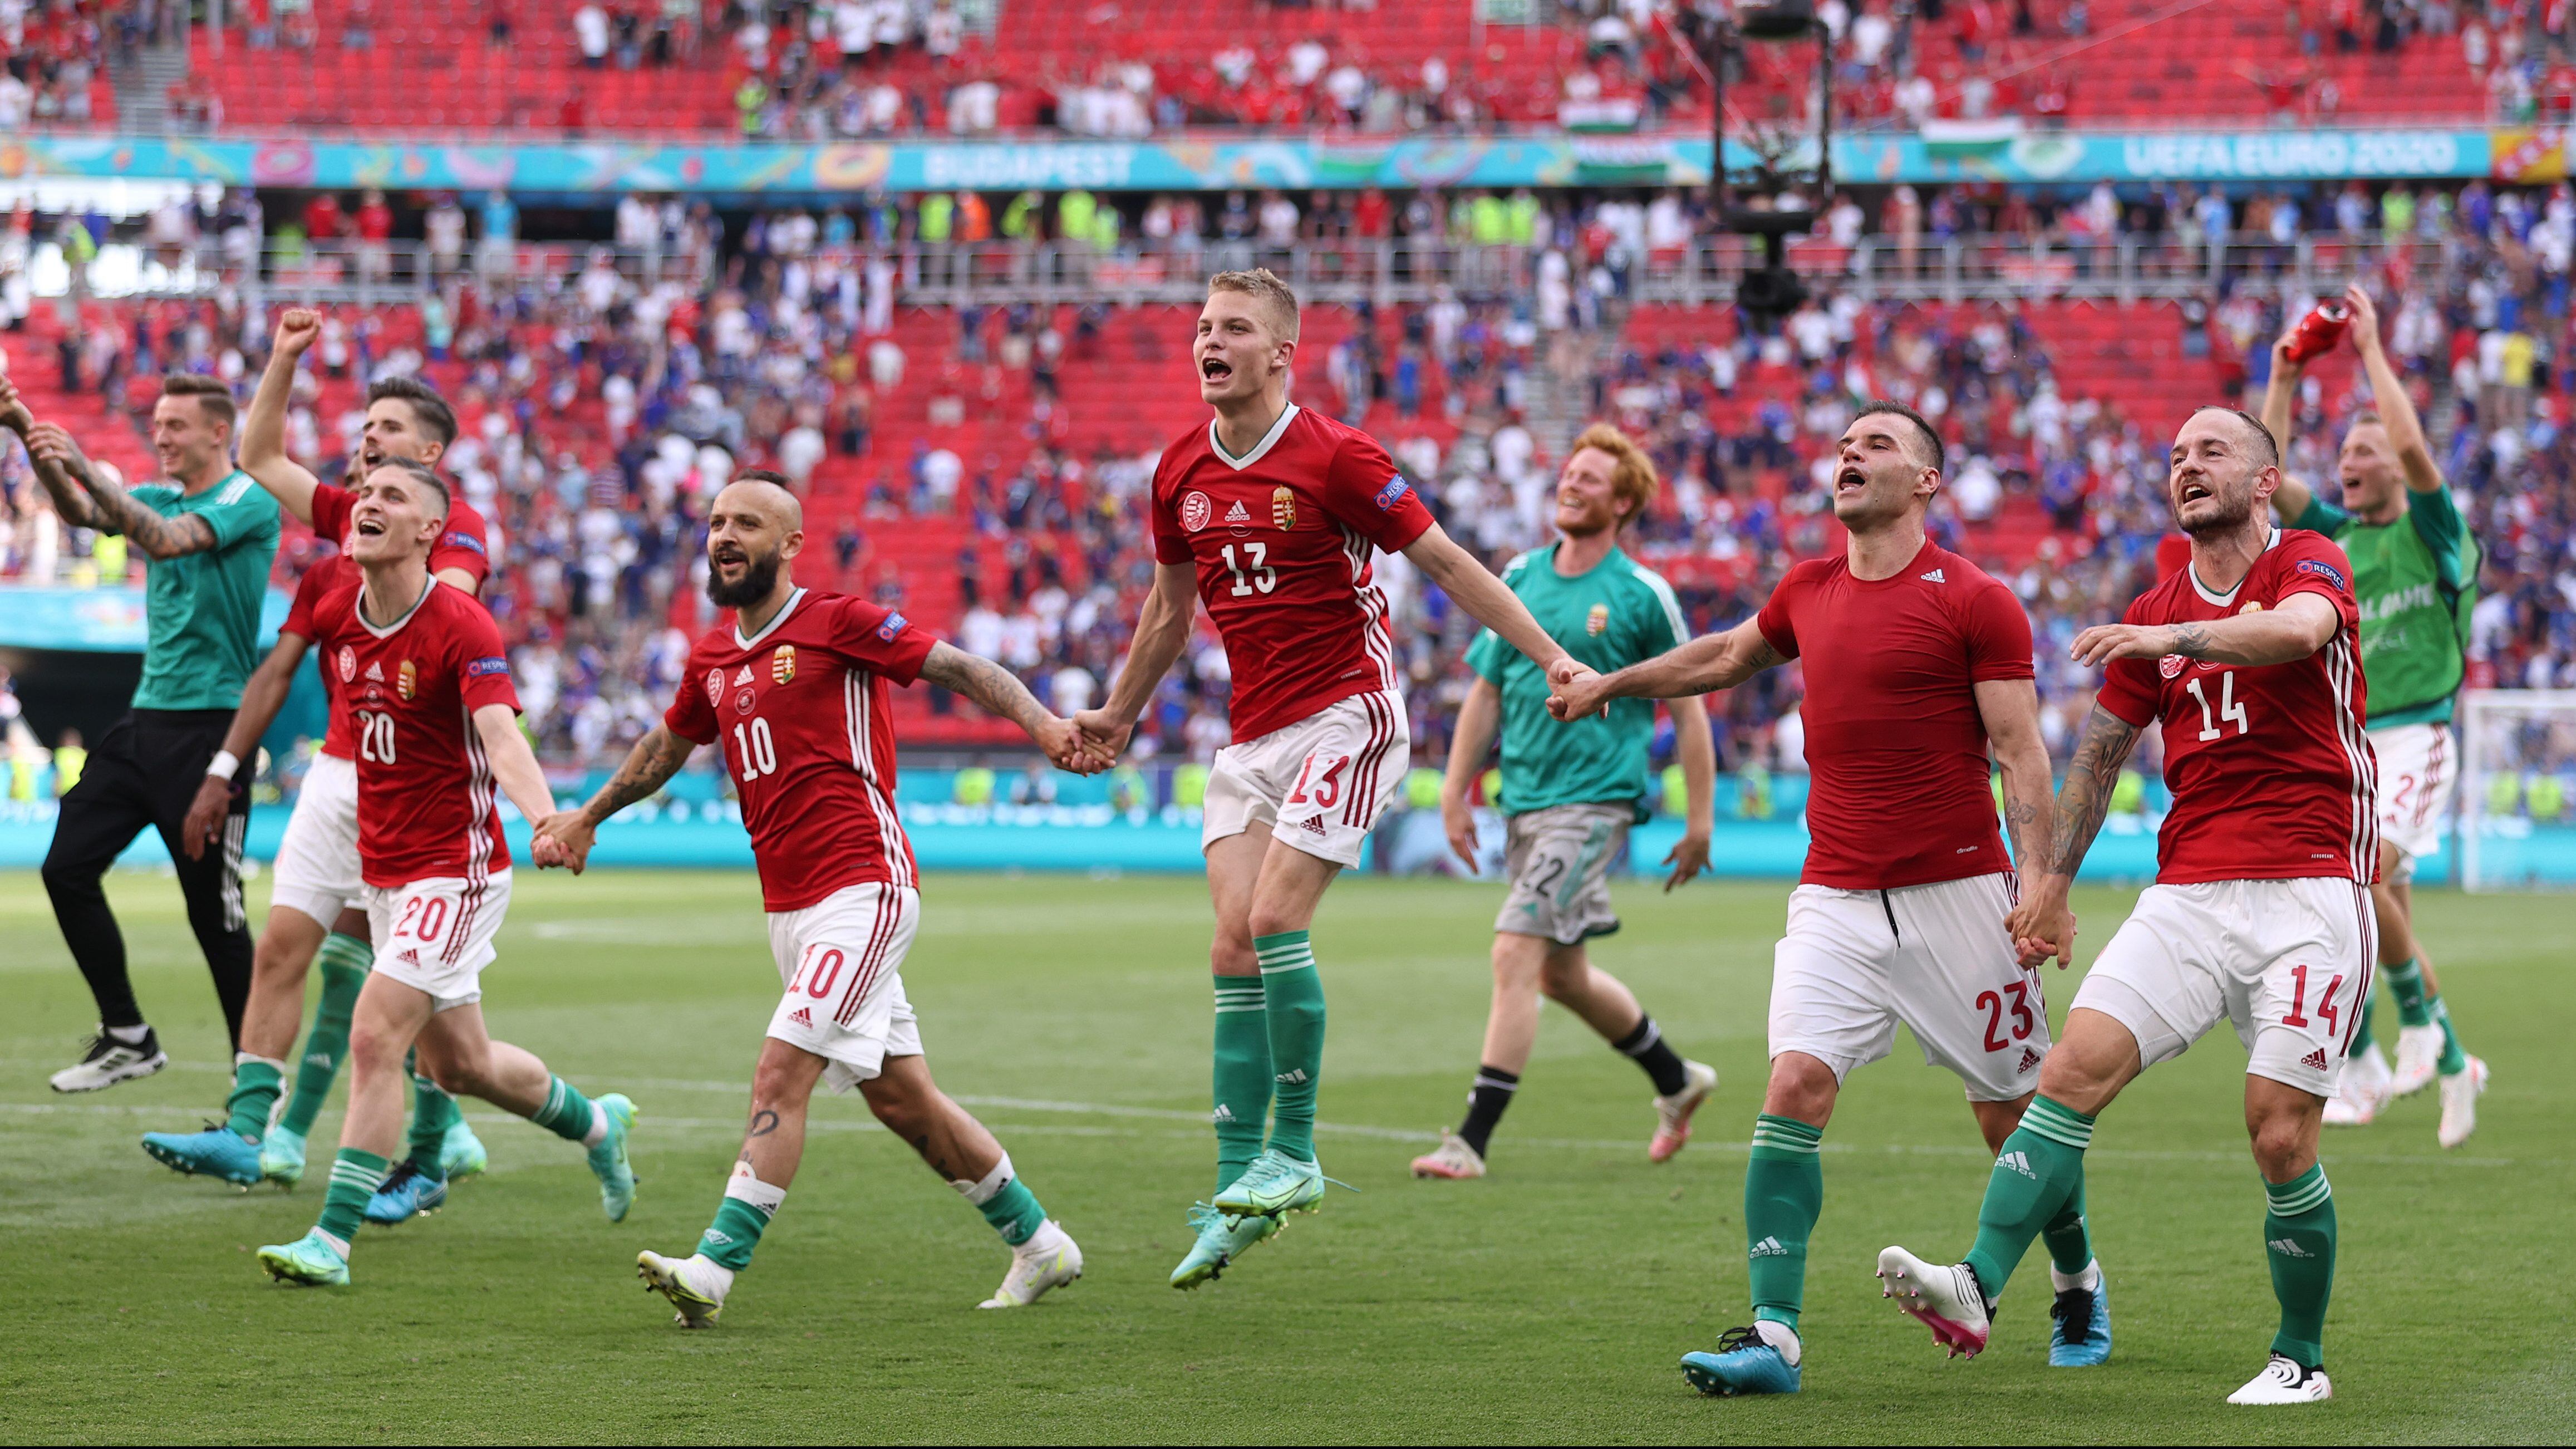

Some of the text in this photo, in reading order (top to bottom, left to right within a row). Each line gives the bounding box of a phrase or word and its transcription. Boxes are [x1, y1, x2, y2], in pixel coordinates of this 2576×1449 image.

[2123, 132, 2228, 176] UEFA
[2234, 131, 2350, 176] EURO
[2352, 131, 2457, 175] 2020
[1225, 513, 1250, 522] adidas
[1221, 542, 1276, 597] 13
[1920, 574, 1946, 584] adidas
[2314, 564, 2343, 588] RESPECT
[2186, 671, 2248, 742] 14
[357, 709, 396, 765] 20
[734, 716, 777, 783] 10
[1288, 751, 1350, 808] 13
[1300, 822, 1326, 837] adidas
[395, 896, 447, 942] 20
[788, 944, 844, 999] 10
[1976, 980, 2033, 1052] 23
[2282, 965, 2343, 1037] 14
[2017, 1055, 2040, 1074] adidas
[2301, 1057, 2327, 1072] adidas
[1994, 1161, 2036, 1180] adidas
[1749, 1248, 1788, 1259] adidas
